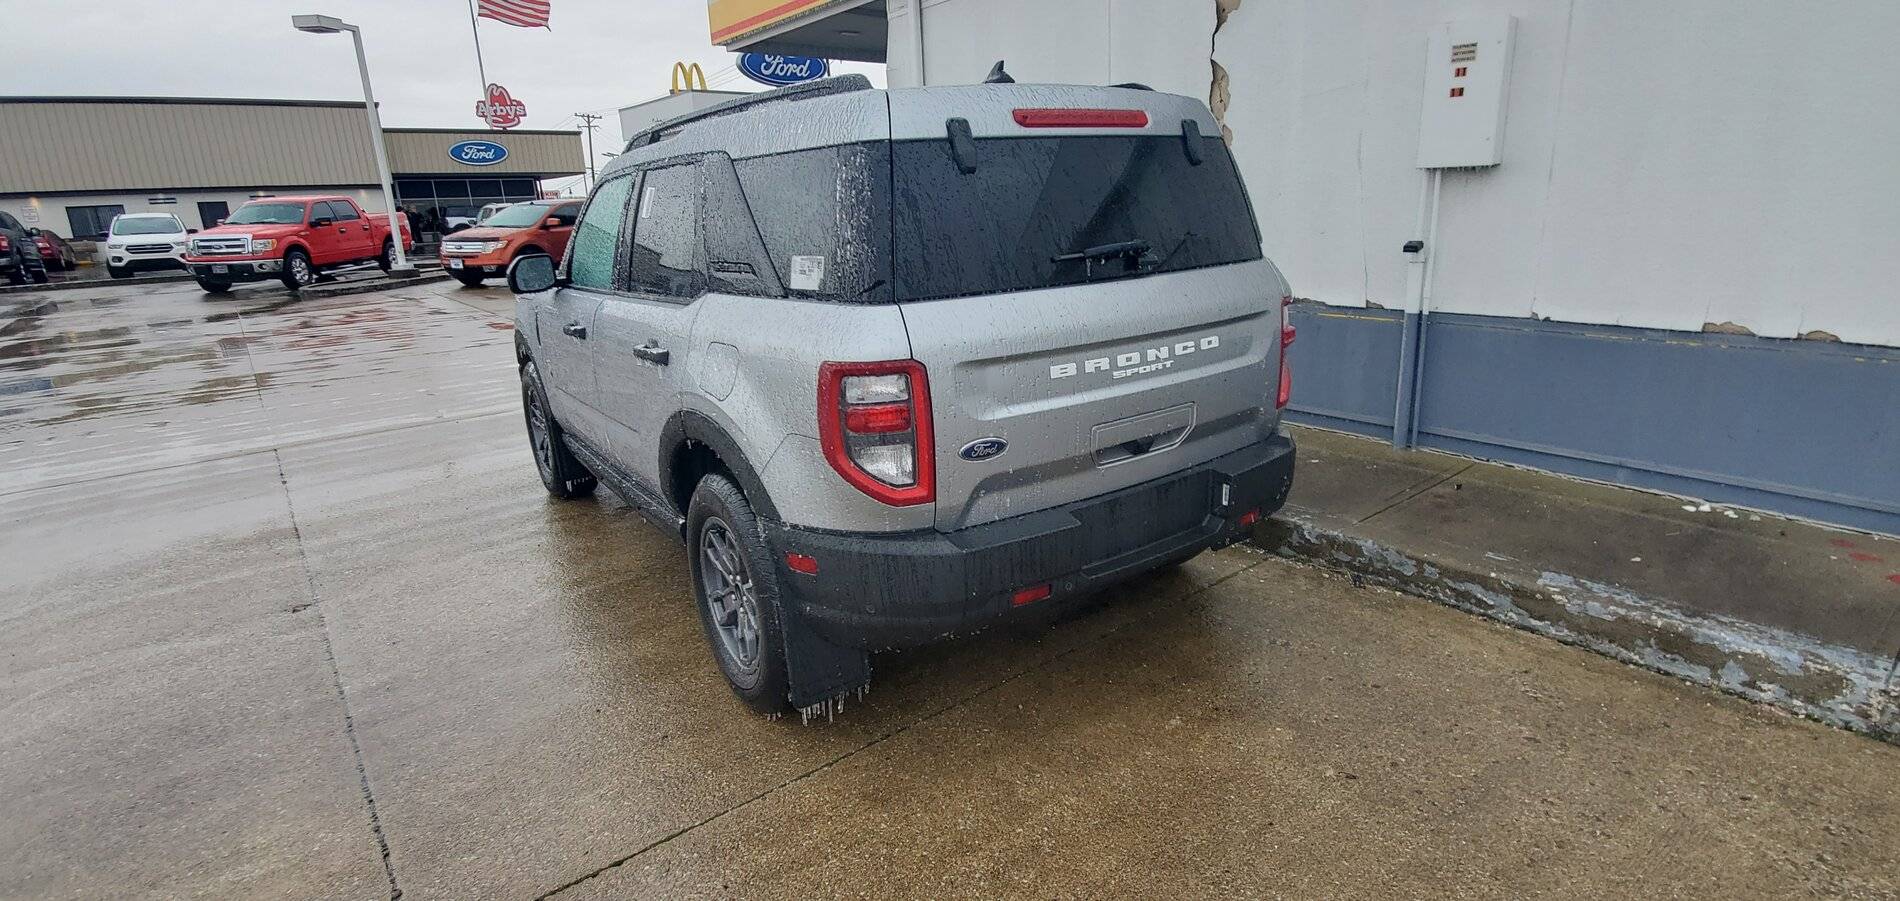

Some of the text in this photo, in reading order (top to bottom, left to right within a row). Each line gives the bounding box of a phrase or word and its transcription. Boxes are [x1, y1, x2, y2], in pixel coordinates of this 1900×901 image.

[461, 145, 495, 160] Ford
[1050, 335, 1219, 379] BRONCO
[1112, 360, 1174, 379] SPORT
[971, 442, 998, 458] Ford
